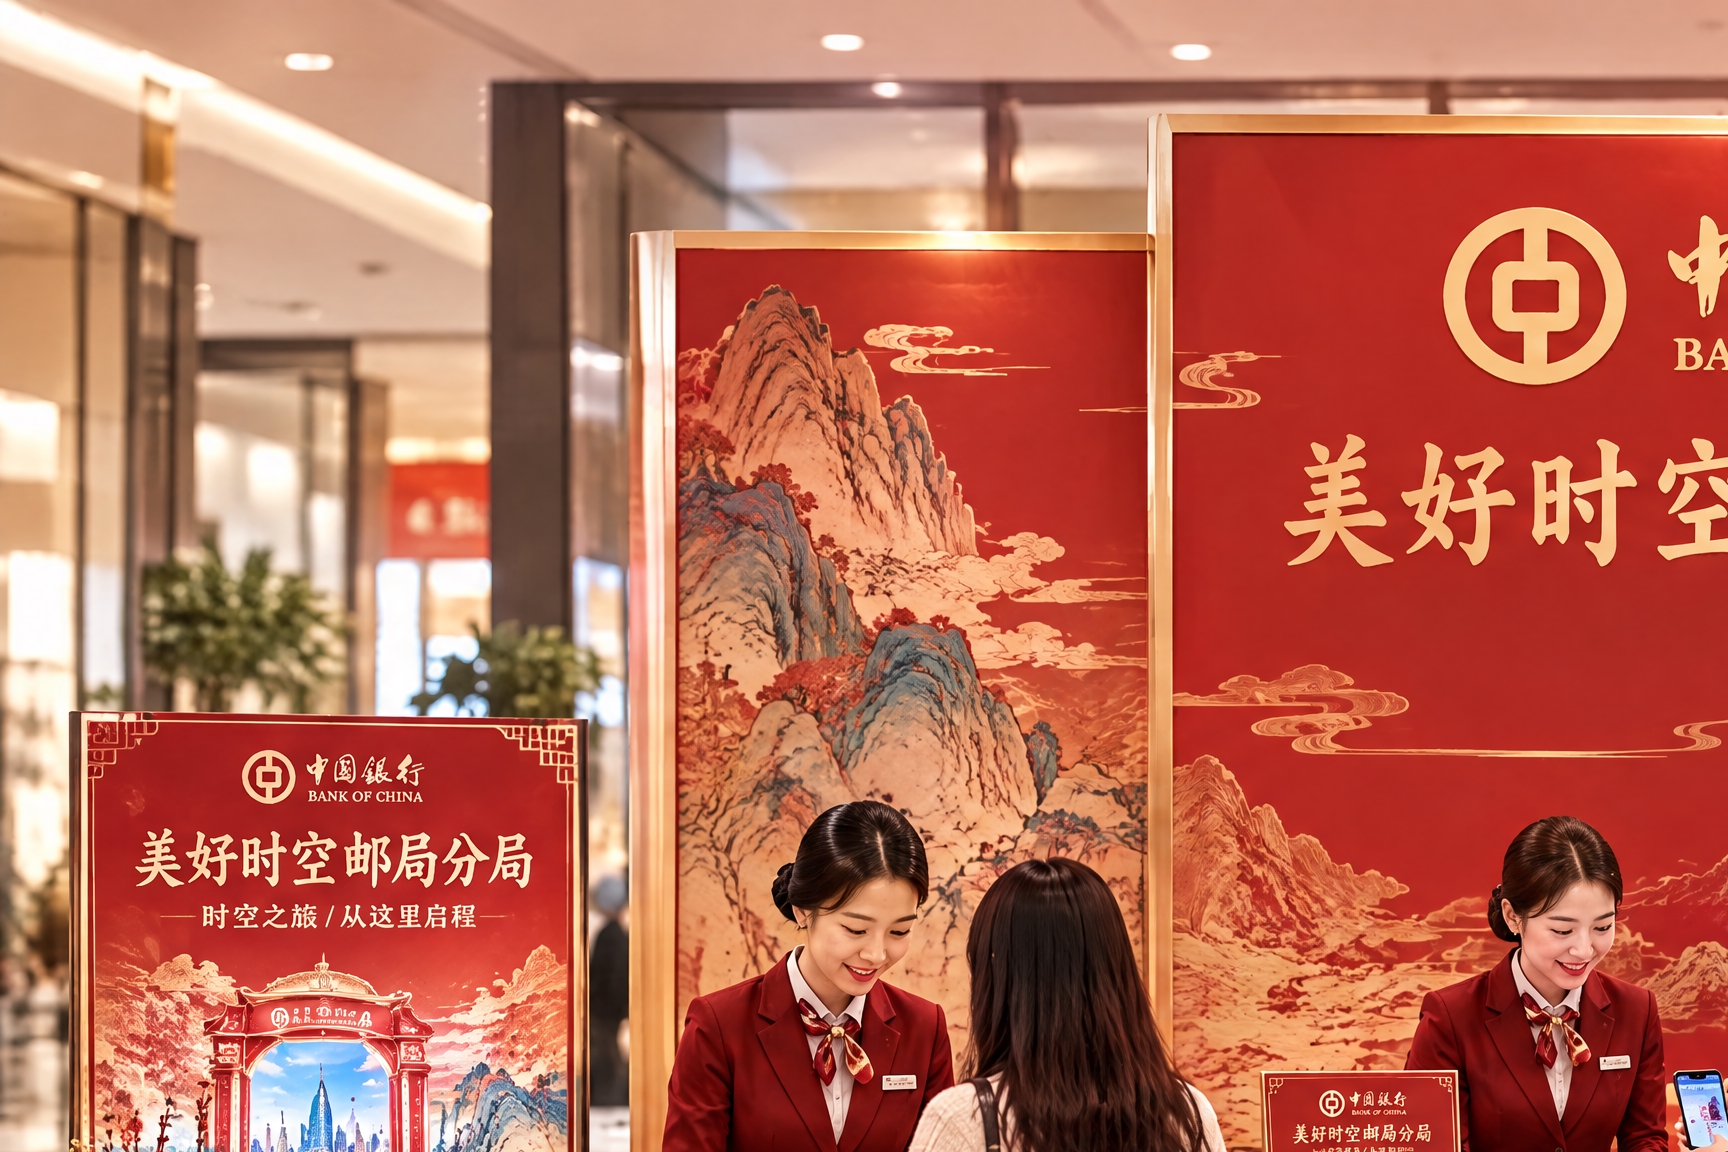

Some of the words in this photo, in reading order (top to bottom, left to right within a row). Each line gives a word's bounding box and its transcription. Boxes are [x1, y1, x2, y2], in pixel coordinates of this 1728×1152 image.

[308, 790, 349, 802] BANK
[351, 790, 373, 803] OF
[375, 790, 424, 803] CHINA
[134, 827, 533, 889] 美好时空邮局分局
